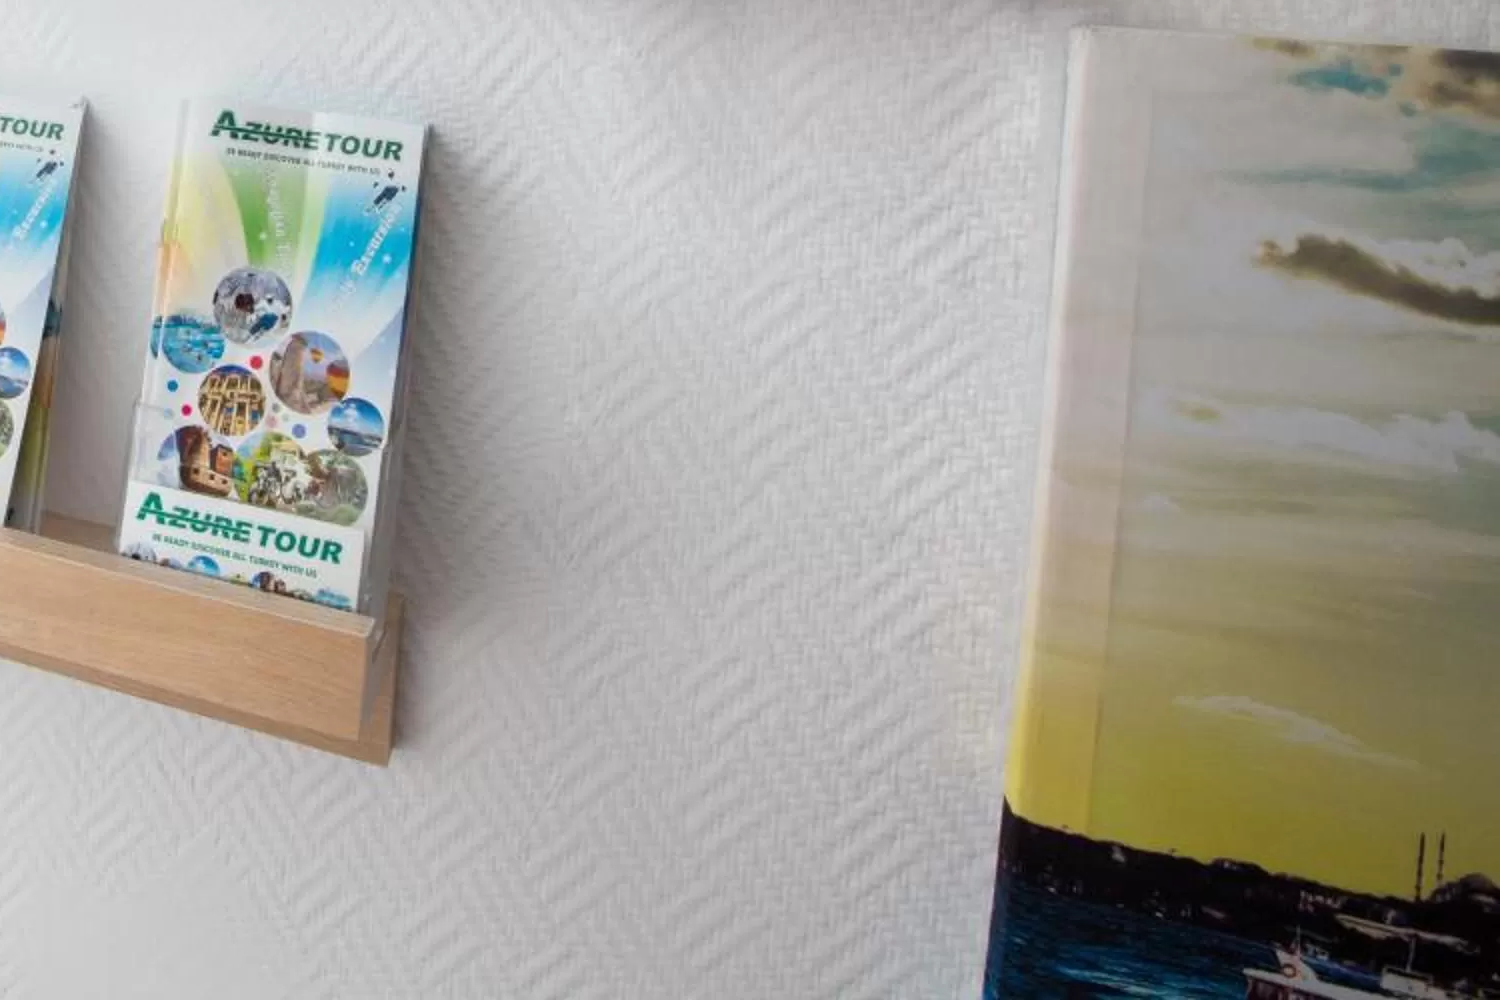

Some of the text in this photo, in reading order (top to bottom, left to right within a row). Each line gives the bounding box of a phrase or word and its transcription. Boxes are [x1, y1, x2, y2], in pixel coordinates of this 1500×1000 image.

[0, 116, 65, 141] TOUR
[209, 110, 404, 162] AZURE TOUR
[135, 491, 344, 564] AZURE TOUR
